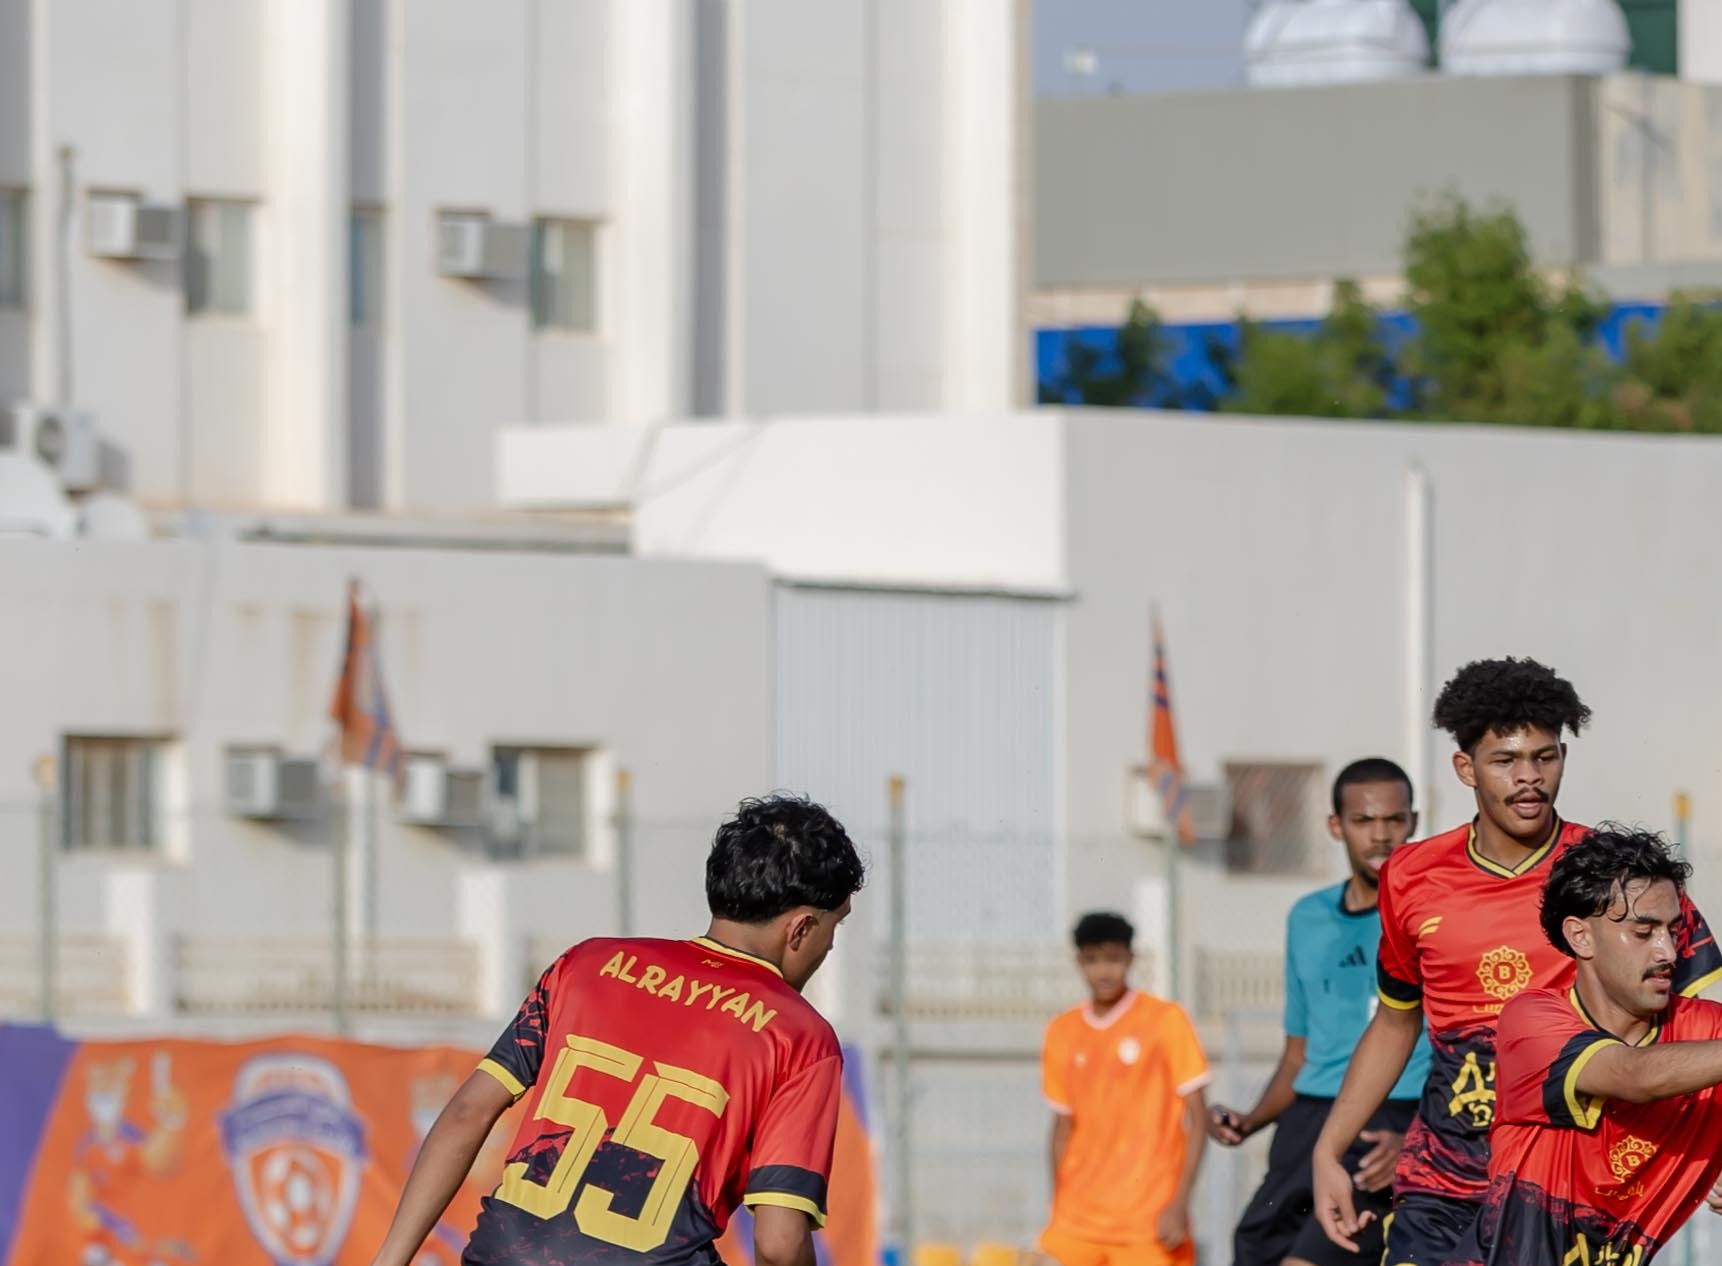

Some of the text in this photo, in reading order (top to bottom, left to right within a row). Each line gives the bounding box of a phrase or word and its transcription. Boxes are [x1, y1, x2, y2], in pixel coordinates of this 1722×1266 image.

[600, 951, 777, 1033] ALRAYYAN
[1499, 965, 1511, 979] B
[494, 1034, 730, 1254] 55
